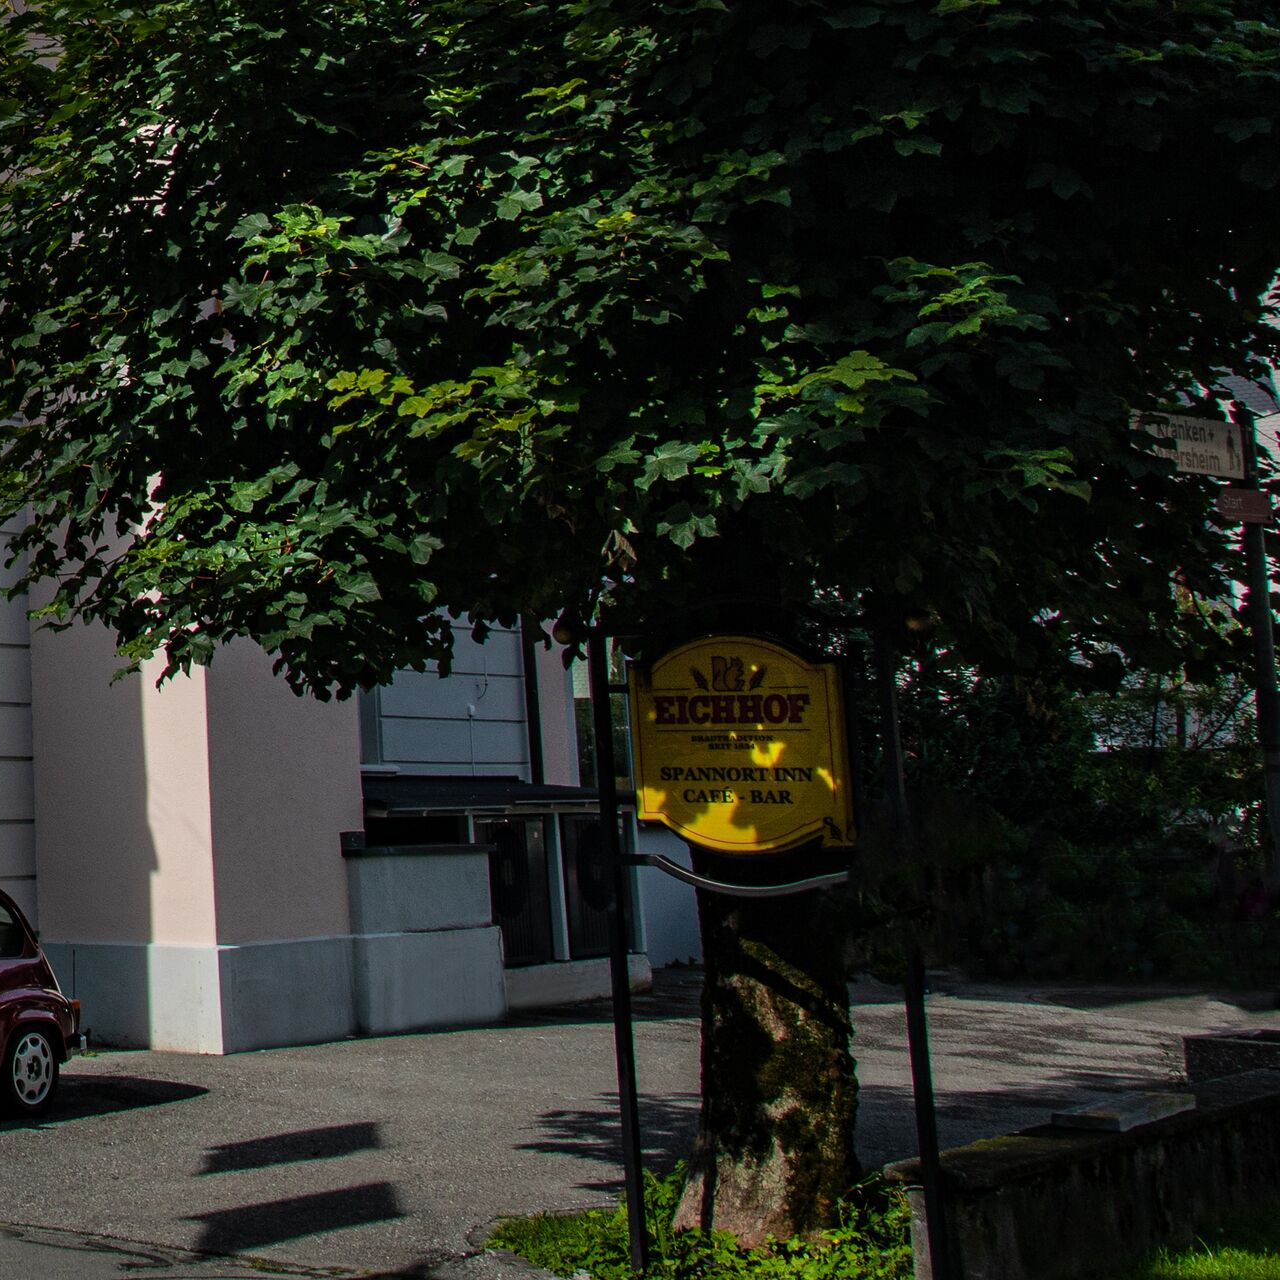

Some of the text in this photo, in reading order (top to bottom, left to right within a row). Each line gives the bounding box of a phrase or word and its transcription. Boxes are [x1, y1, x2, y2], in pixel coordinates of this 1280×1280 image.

[654, 694, 811, 724] EICHHOF
[660, 766, 813, 782] SPANNORT INN
[683, 785, 734, 804] CAFÉ
[750, 789, 794, 805] BAR
